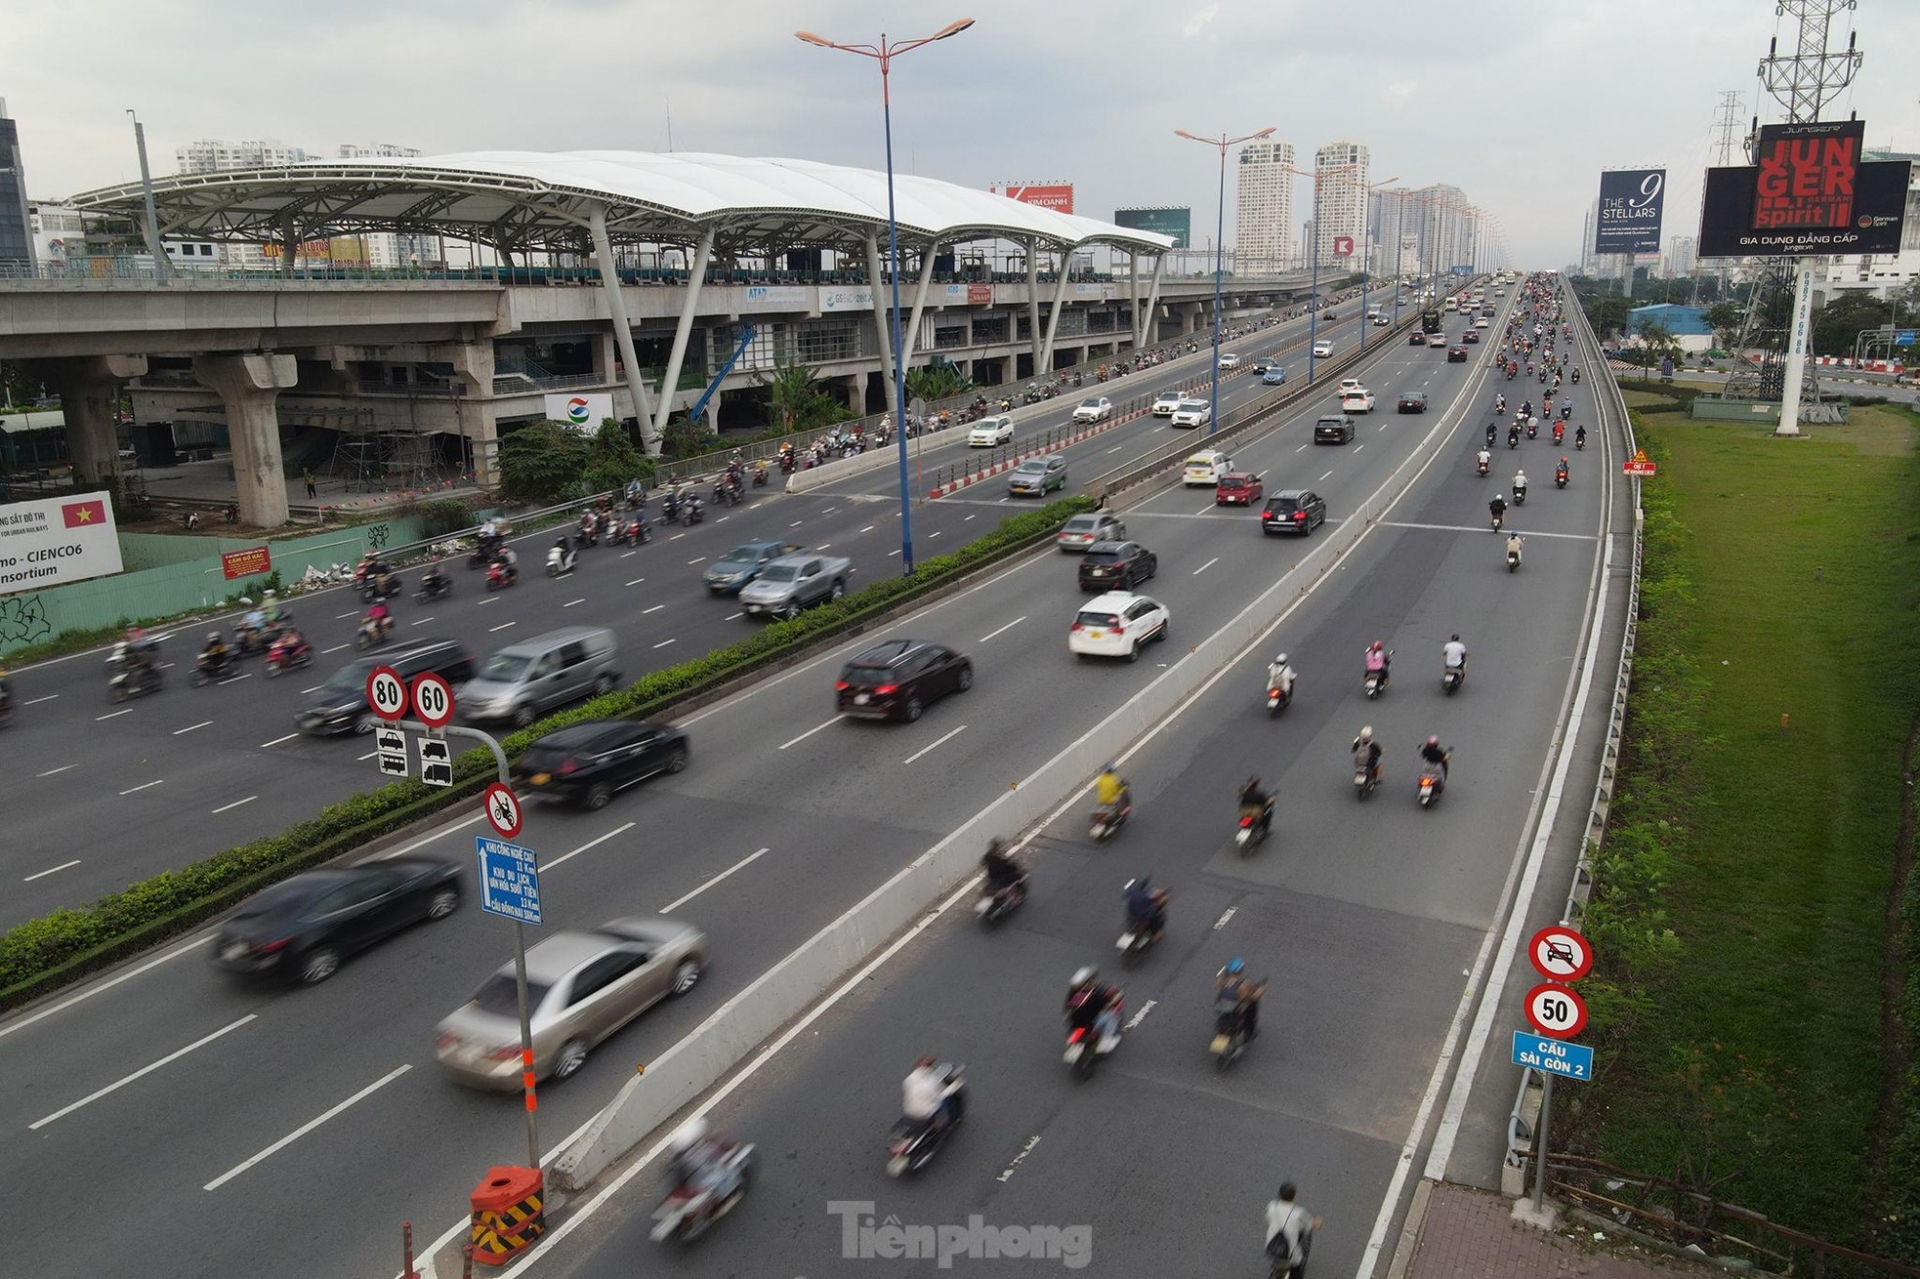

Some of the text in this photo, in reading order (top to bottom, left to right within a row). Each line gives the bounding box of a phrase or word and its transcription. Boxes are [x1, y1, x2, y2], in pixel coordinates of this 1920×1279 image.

[1628, 173, 1662, 208] 9
[1604, 198, 1624, 208] THE
[1602, 207, 1656, 219] STELLARS
[1739, 237, 1758, 245] GIA
[1761, 236, 1794, 246] DỤNG
[1833, 231, 1859, 243] CẤP
[27, 544, 83, 563] CIENCO6
[376, 680, 398, 706] 80
[421, 686, 444, 712] 60
[492, 866, 505, 879] KHU
[1543, 998, 1567, 1022] 50
[1538, 1041, 1567, 1057] CẦU
[1519, 1051, 1584, 1076] SÀI GÒN 2
